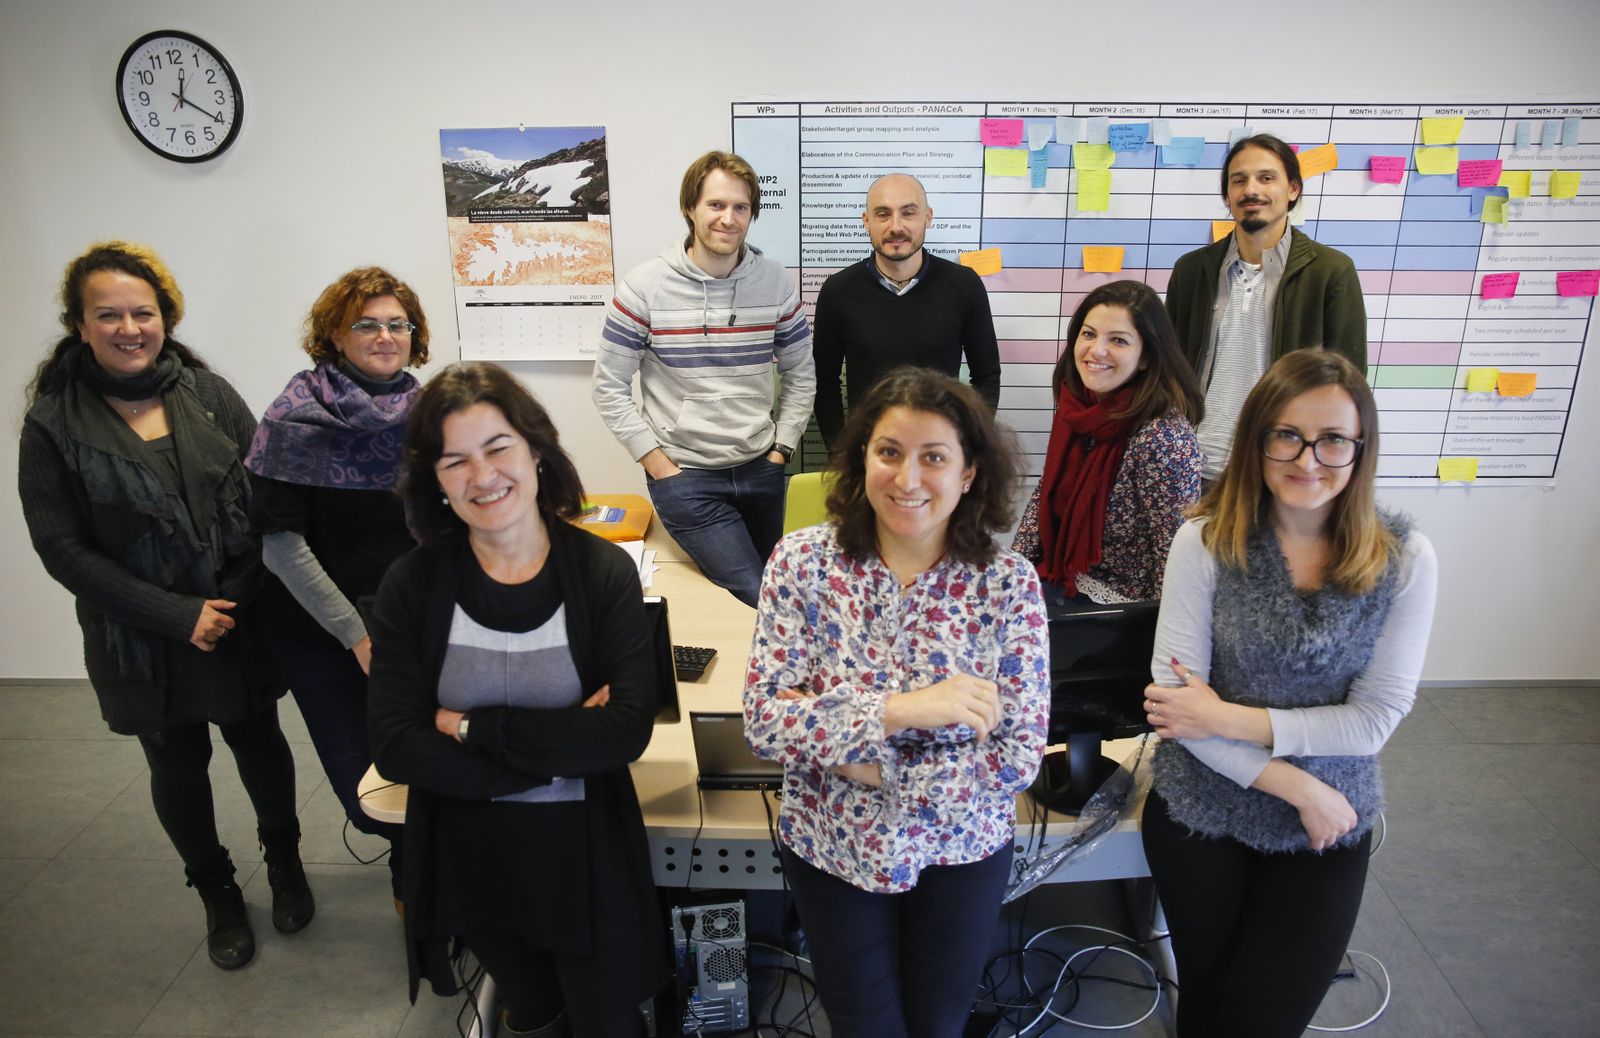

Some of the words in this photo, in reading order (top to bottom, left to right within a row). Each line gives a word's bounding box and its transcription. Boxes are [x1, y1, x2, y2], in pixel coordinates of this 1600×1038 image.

[148, 54, 162, 70] 11
[166, 49, 183, 65] 12
[192, 53, 199, 68] 1
[137, 70, 154, 85] 10
[205, 69, 217, 84] 2
[138, 91, 150, 106] 9
[214, 90, 225, 105] 3
[756, 106, 776, 114] WPs
[824, 106, 863, 114] Activities
[882, 106, 915, 114] Outputs
[922, 105, 963, 113] PANACeA
[148, 112, 160, 127] 8
[214, 111, 225, 125] 4
[165, 127, 177, 142] 7
[184, 130, 196, 145] 6
[203, 126, 215, 141] 5
[756, 176, 778, 184] WP2
[759, 189, 787, 197] ternal
